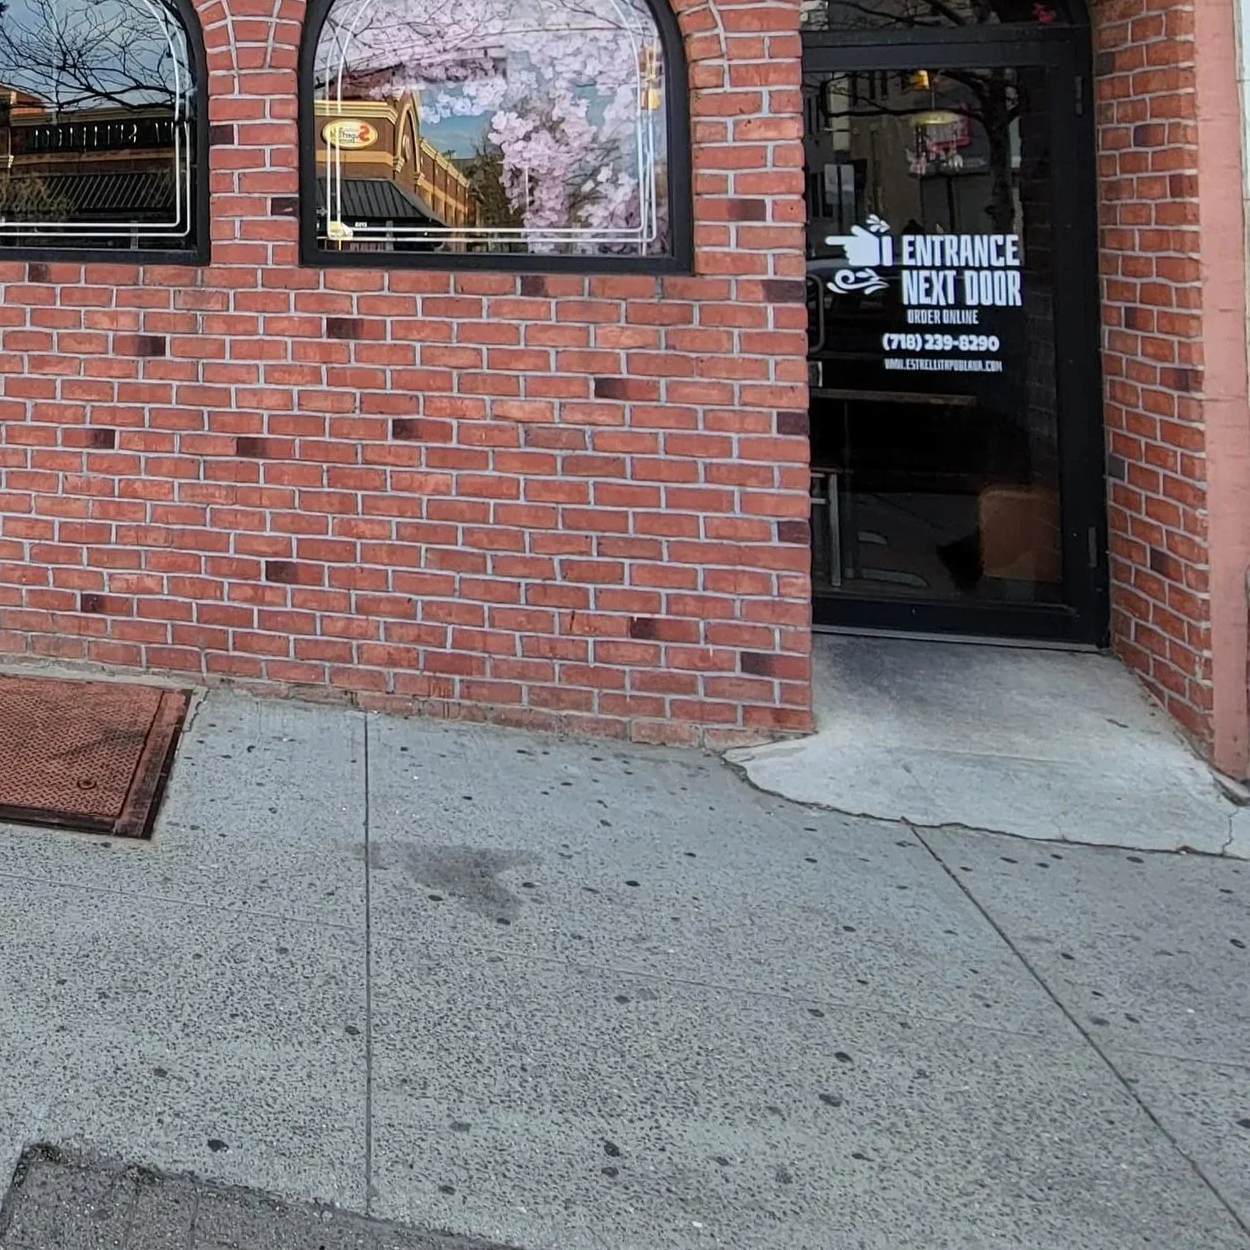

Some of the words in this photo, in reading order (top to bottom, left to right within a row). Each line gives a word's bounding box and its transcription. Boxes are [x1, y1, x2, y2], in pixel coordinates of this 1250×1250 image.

[902, 234, 1021, 267] ENTRANCE
[902, 269, 957, 305] NEXT
[964, 270, 1022, 306] DOOR
[907, 309, 941, 324] ORDER
[942, 309, 979, 324] ONLINE
[882, 333, 923, 351] (718)
[924, 334, 1000, 352] 239-8290
